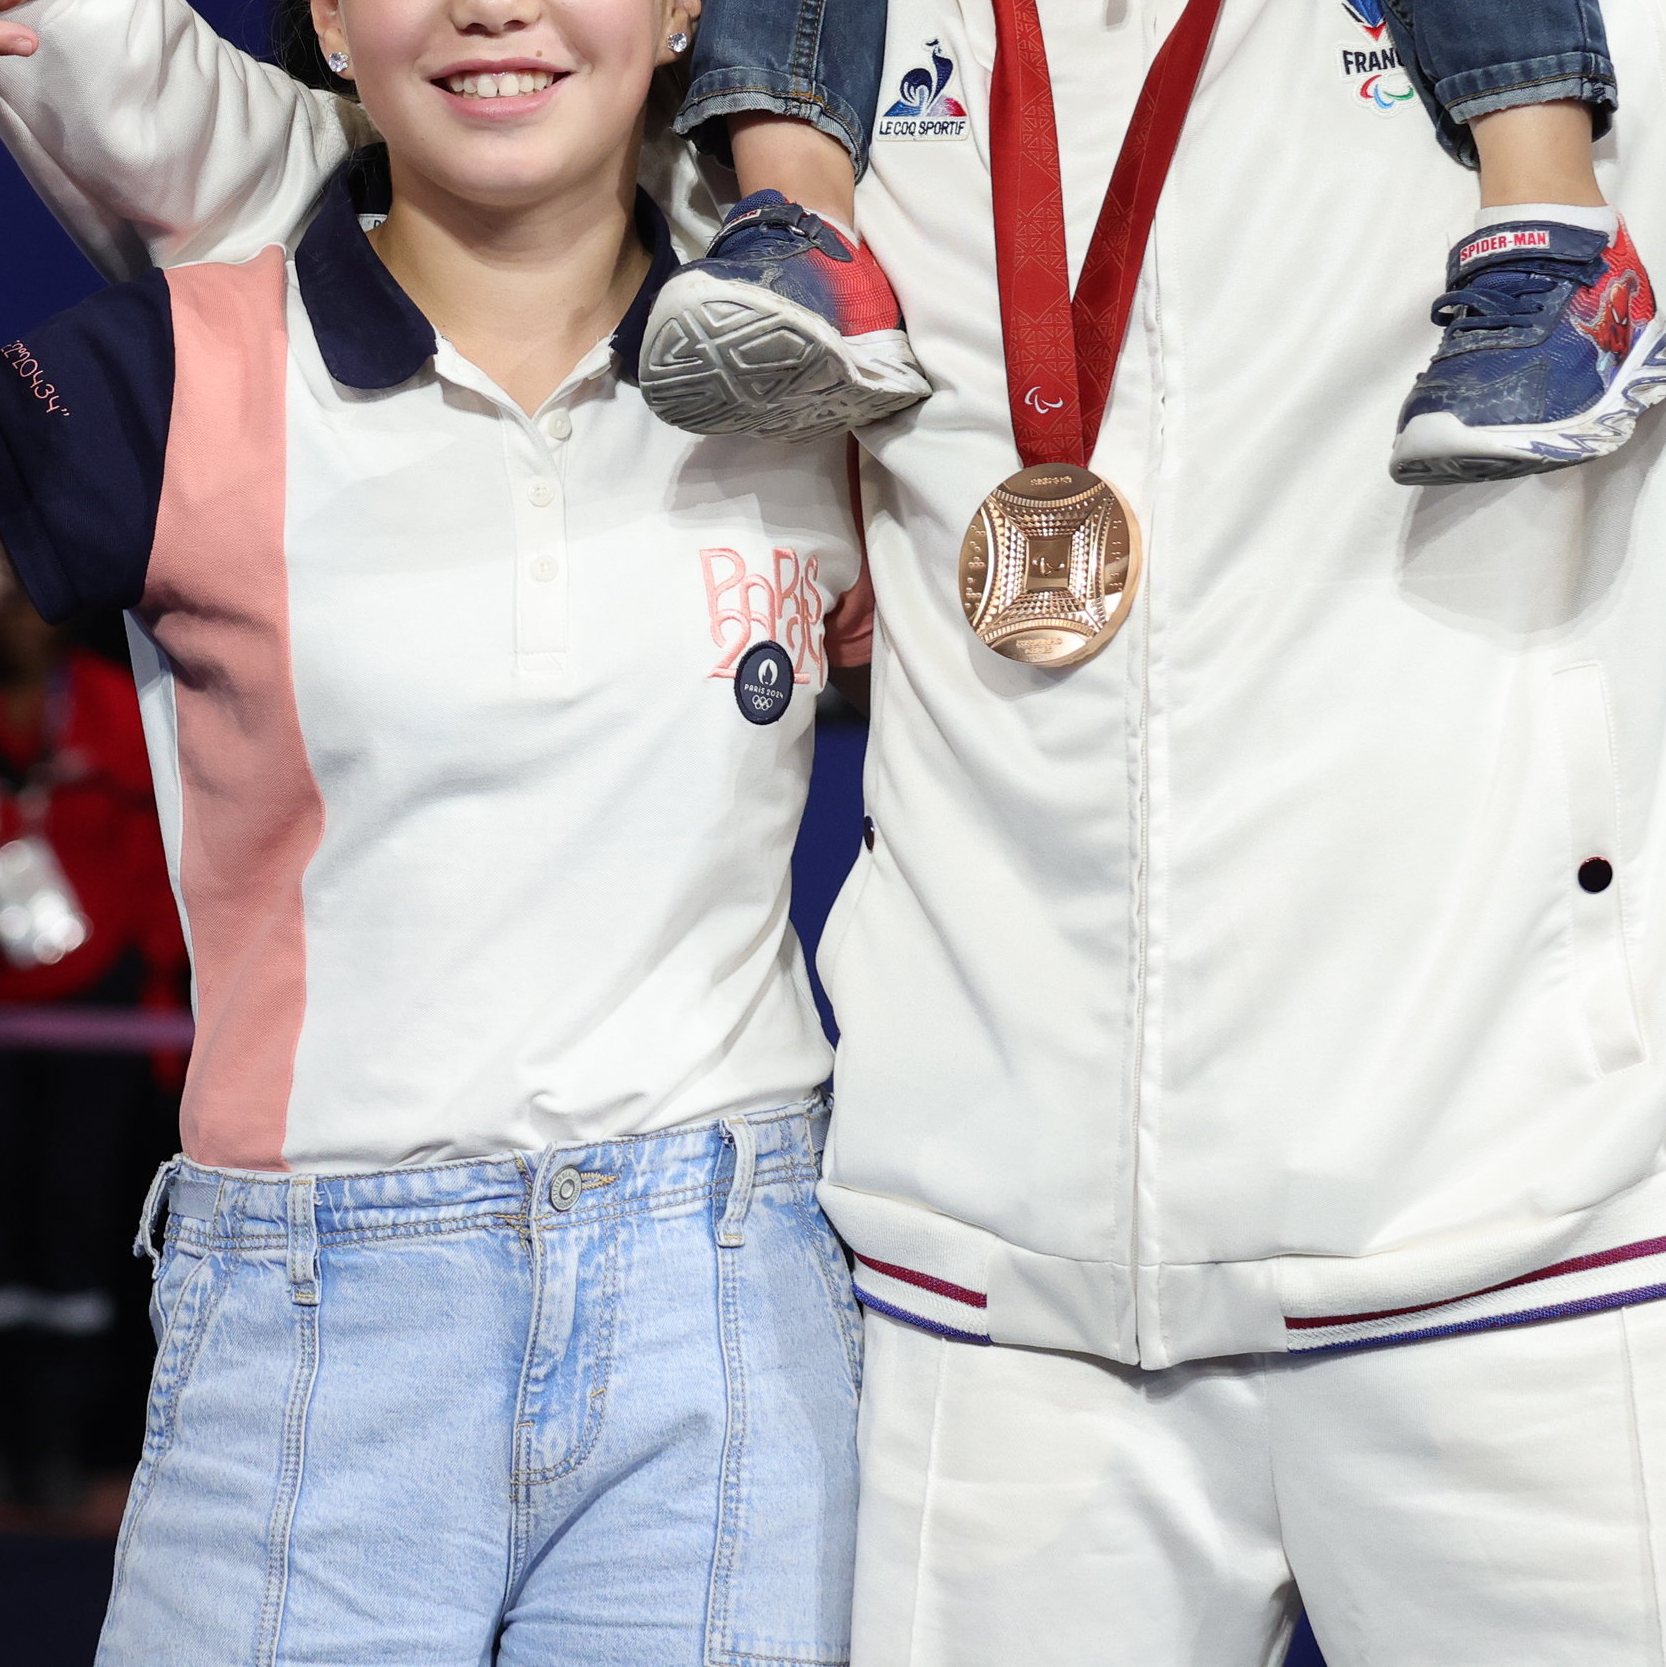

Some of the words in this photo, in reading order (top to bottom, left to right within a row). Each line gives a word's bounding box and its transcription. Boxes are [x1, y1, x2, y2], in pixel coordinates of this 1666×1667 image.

[879, 120, 893, 136] LE
[894, 120, 917, 137] COQ
[918, 120, 966, 135] SPORTIF
[1460, 232, 1547, 262] SPIDER-MAN
[766, 688, 784, 699] 2024
